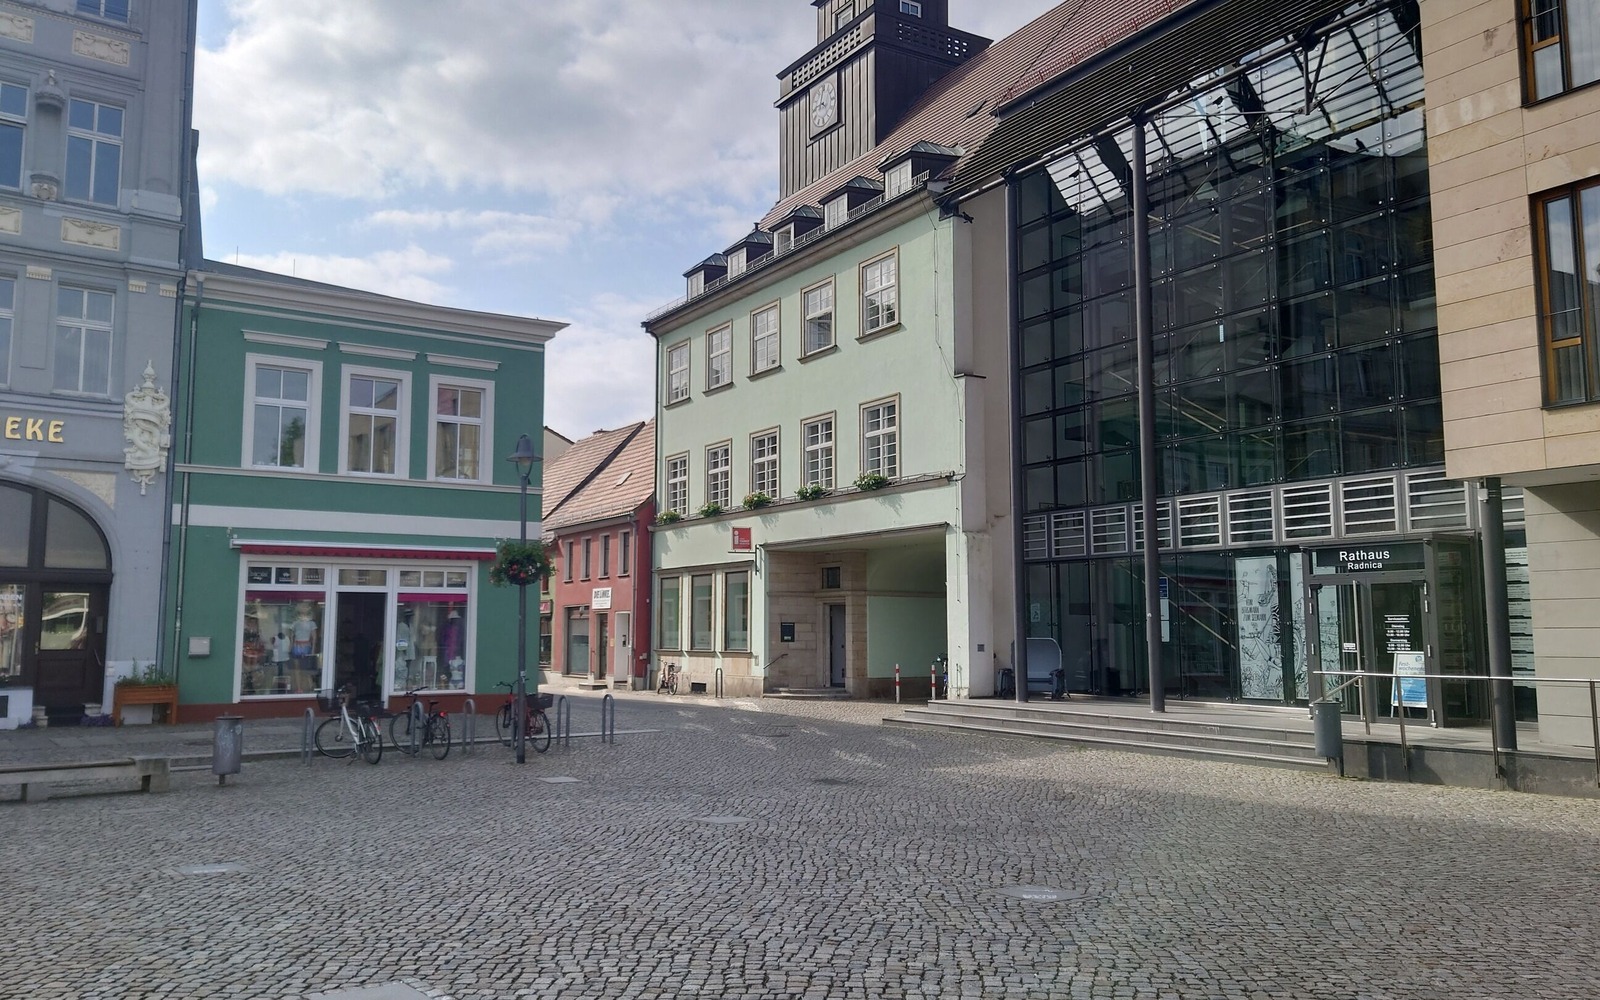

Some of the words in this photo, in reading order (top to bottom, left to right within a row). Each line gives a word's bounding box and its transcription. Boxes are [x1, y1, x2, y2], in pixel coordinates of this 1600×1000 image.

[5, 416, 65, 443] EKE
[1339, 550, 1390, 561] Rathaus
[1347, 562, 1383, 570] Radnica
